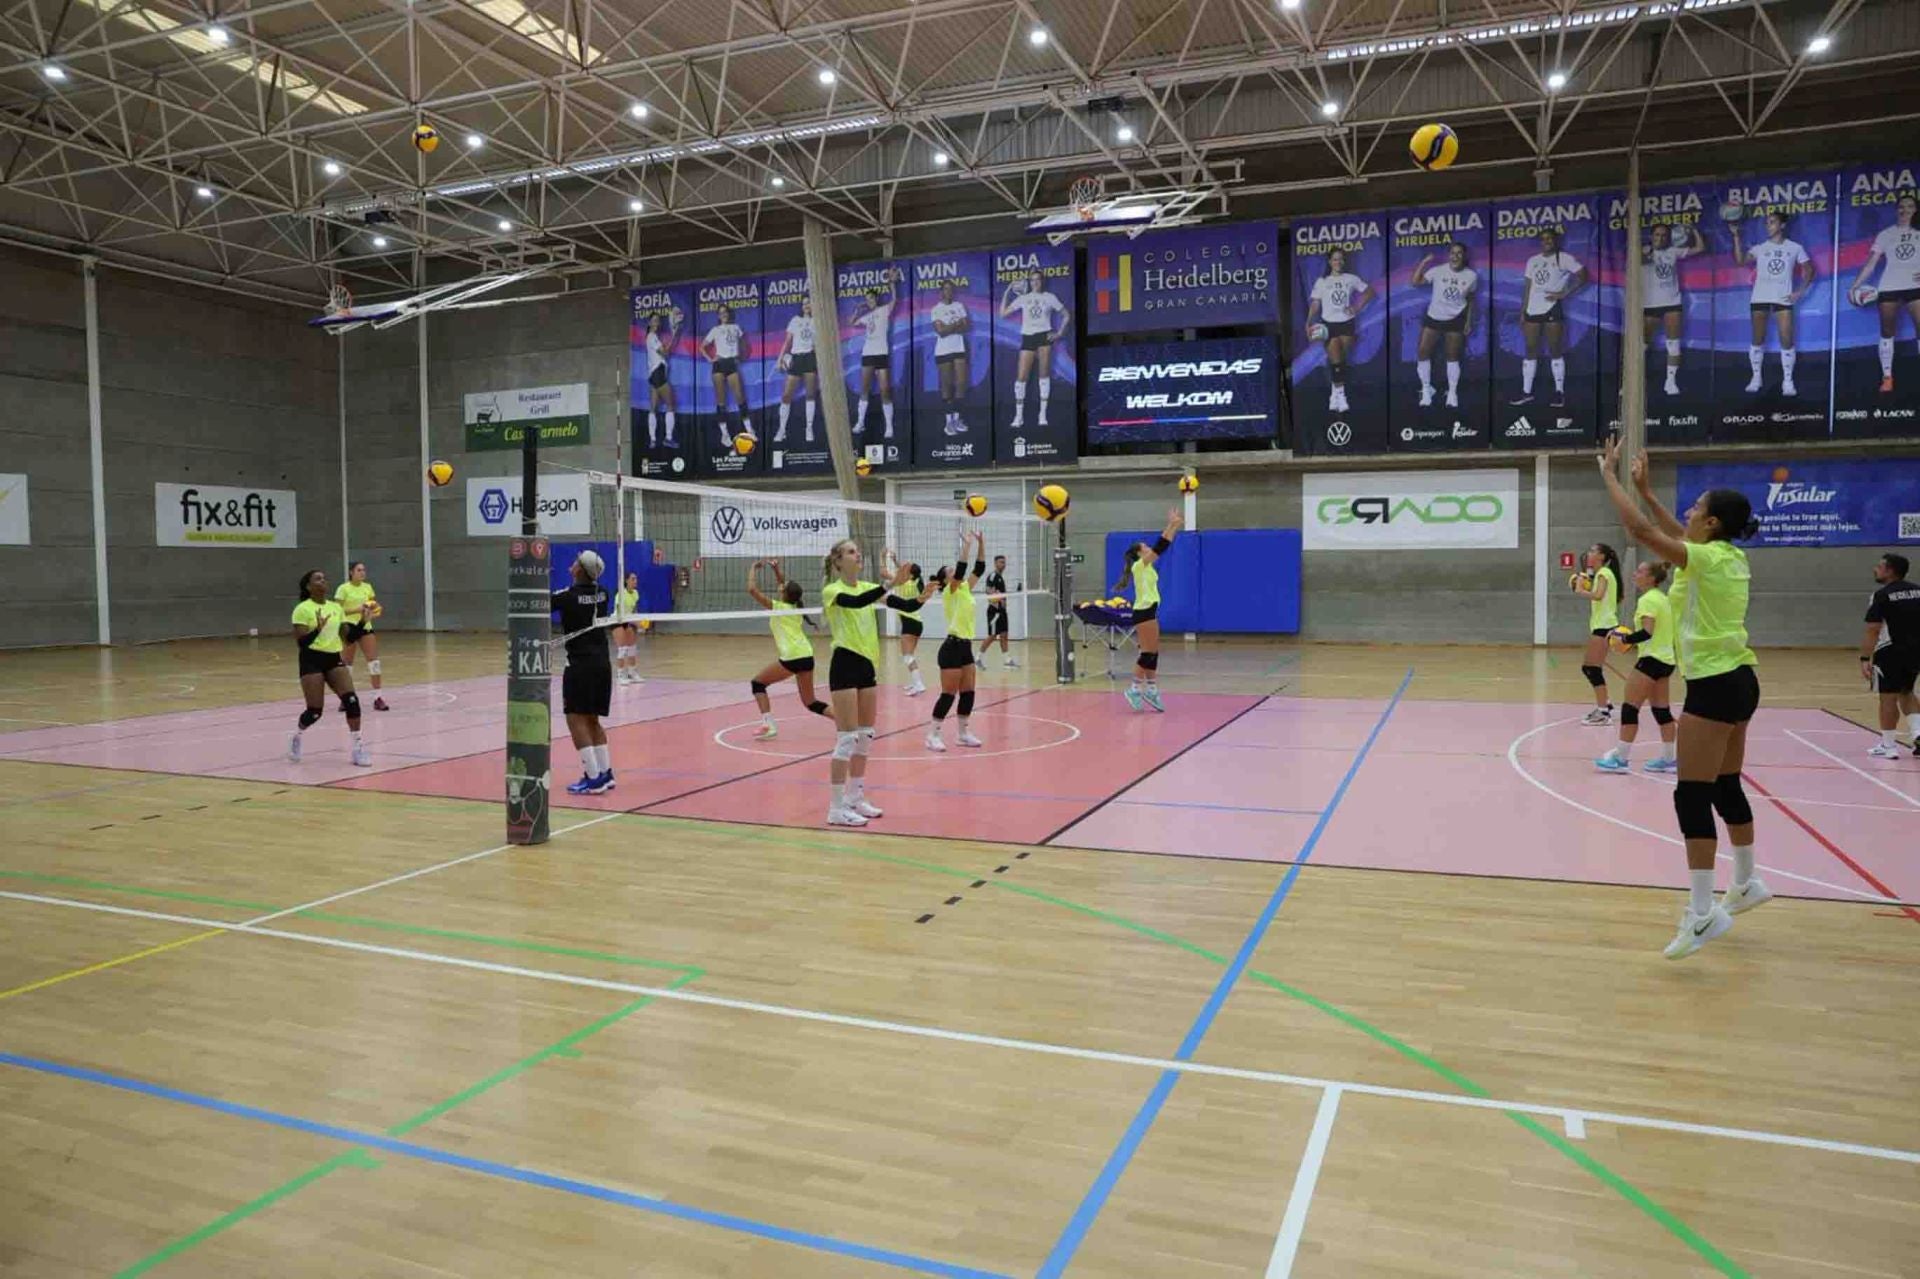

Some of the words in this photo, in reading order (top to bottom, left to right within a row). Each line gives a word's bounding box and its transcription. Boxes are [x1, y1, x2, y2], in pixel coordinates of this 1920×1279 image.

[1852, 168, 1917, 193] ANA
[1728, 179, 1828, 205] BLANCA
[1394, 212, 1484, 235] CAMILA
[1497, 202, 1592, 228] DAYANA
[1296, 221, 1381, 244] CLAUDIA
[1395, 233, 1452, 247] HIRUELA
[996, 253, 1040, 271] LOLA
[1144, 242, 1268, 263] COLEGIO
[916, 261, 958, 280] WIN
[1143, 263, 1268, 291] Heidelberg
[634, 289, 672, 310] SOFÍA
[700, 283, 759, 302] CANDELA
[1144, 298, 1187, 310] GRAN
[1195, 291, 1268, 306] CANARIA
[530, 404, 550, 416] Grill
[1126, 391, 1233, 409] WELKOM
[504, 426, 524, 441] Cas
[540, 421, 578, 438] armelo
[1766, 482, 1837, 511] Insular
[180, 489, 277, 531] fix&fit
[752, 517, 838, 532] Volkswagen
